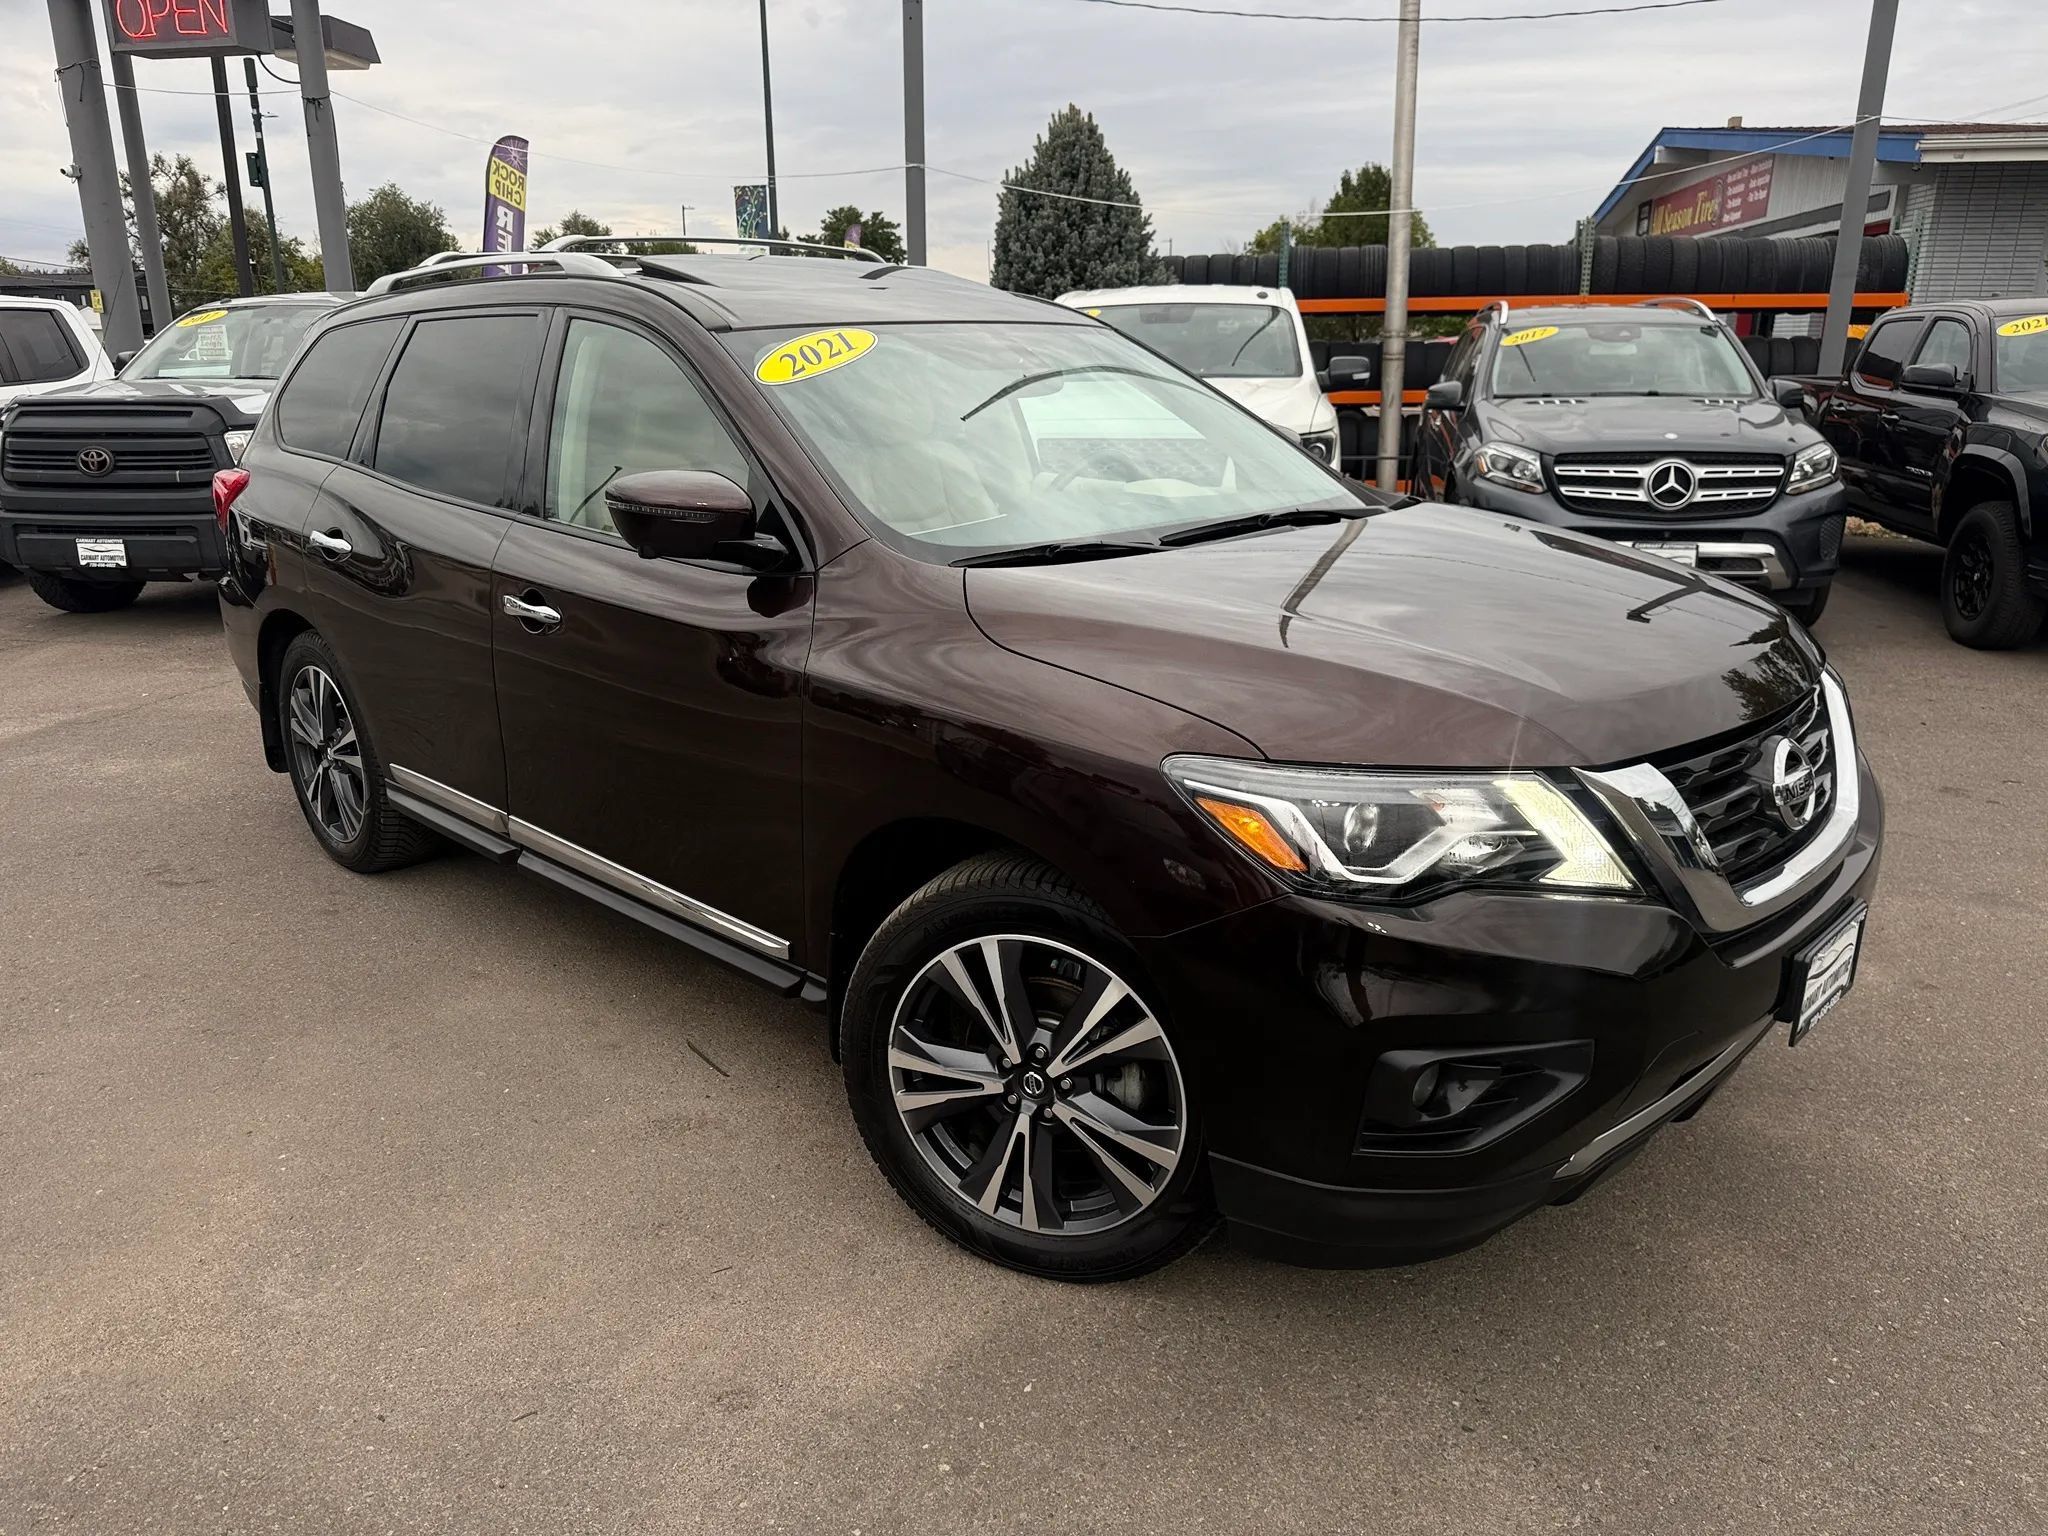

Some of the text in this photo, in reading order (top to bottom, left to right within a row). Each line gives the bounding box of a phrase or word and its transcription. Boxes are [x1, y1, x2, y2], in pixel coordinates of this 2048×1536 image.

[116, 0, 228, 38] OPEN
[1662, 203, 1693, 234] Season
[1511, 328, 1549, 345] 2017
[779, 332, 858, 377] 2021
